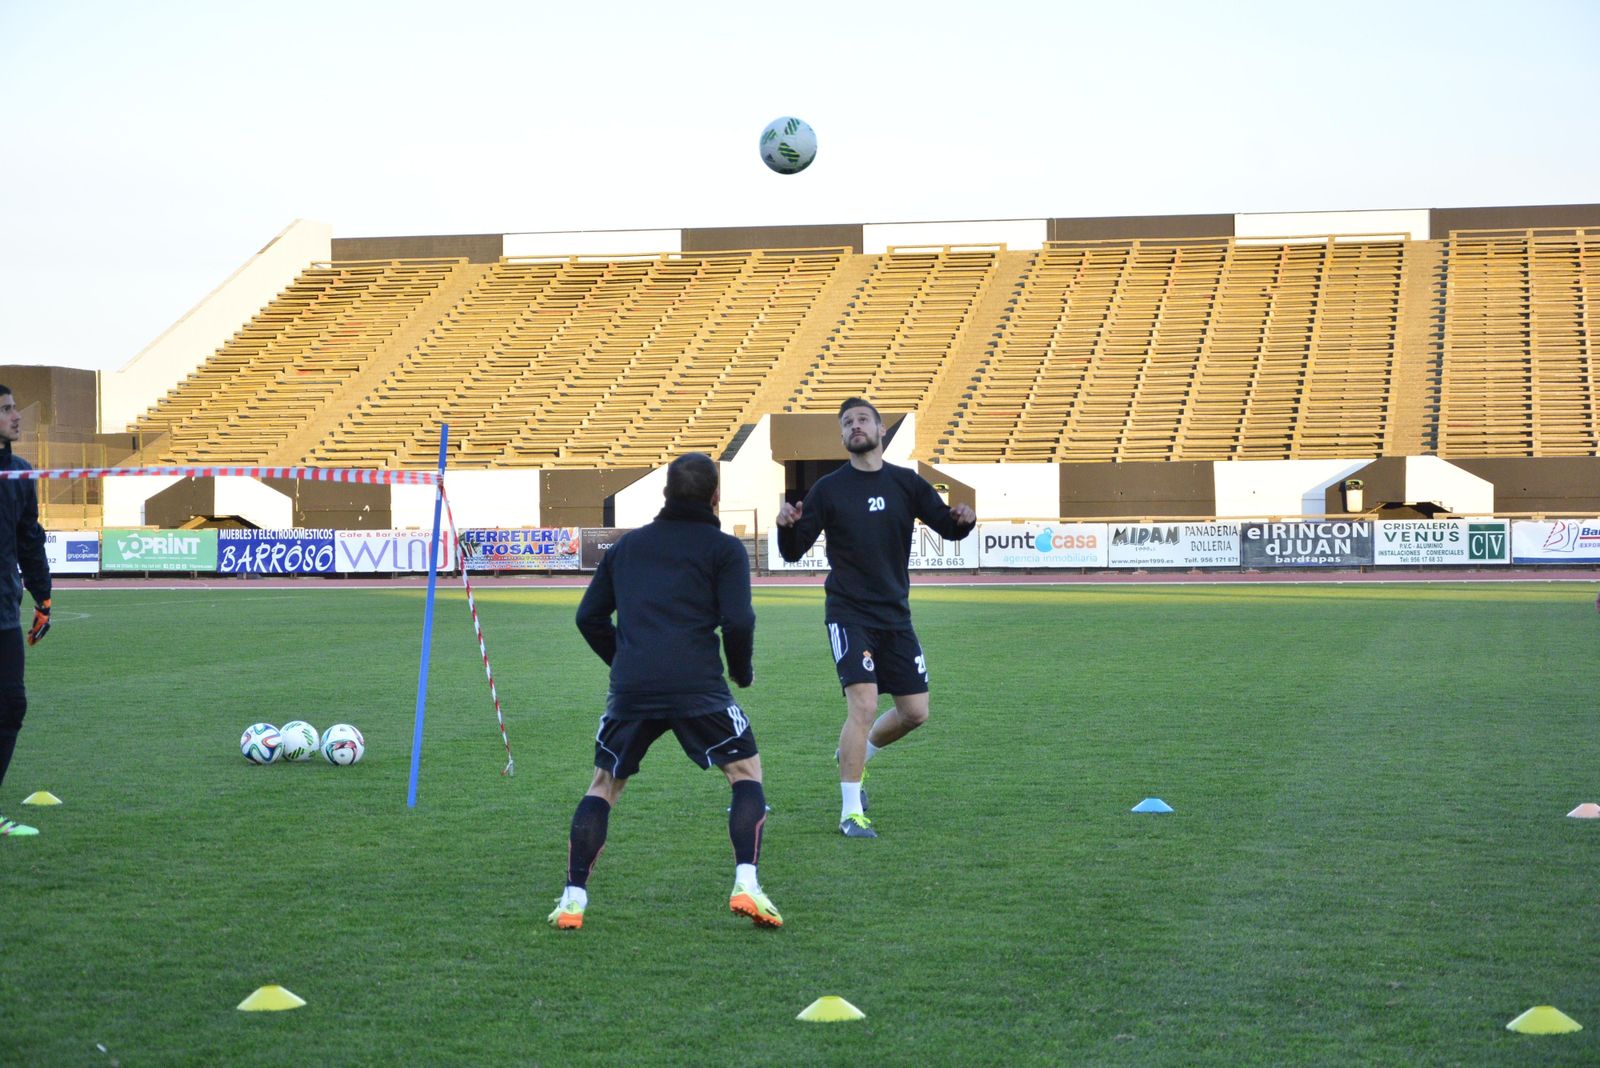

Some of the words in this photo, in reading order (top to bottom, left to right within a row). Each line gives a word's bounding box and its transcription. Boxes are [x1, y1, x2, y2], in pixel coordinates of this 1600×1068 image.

[868, 497, 885, 511] 20
[220, 529, 251, 540] MUEBLES
[253, 530, 258, 540] Y
[260, 529, 333, 540] ELECTRODOMESTICOS
[1112, 526, 1180, 546] MIPAN
[1185, 525, 1238, 536] PANADERIA
[466, 531, 570, 542] FERRETERIA
[1384, 531, 1460, 542] VENUS
[482, 543, 555, 555] ROSAJE
[1191, 540, 1232, 551] BOLLERIA
[1265, 539, 1351, 555] dJUAN
[220, 541, 333, 573] BARROSO
[925, 558, 943, 566] 126
[946, 558, 965, 566] 663
[1003, 555, 1040, 564] agencia
[1043, 553, 1098, 562] inmobiliaria
